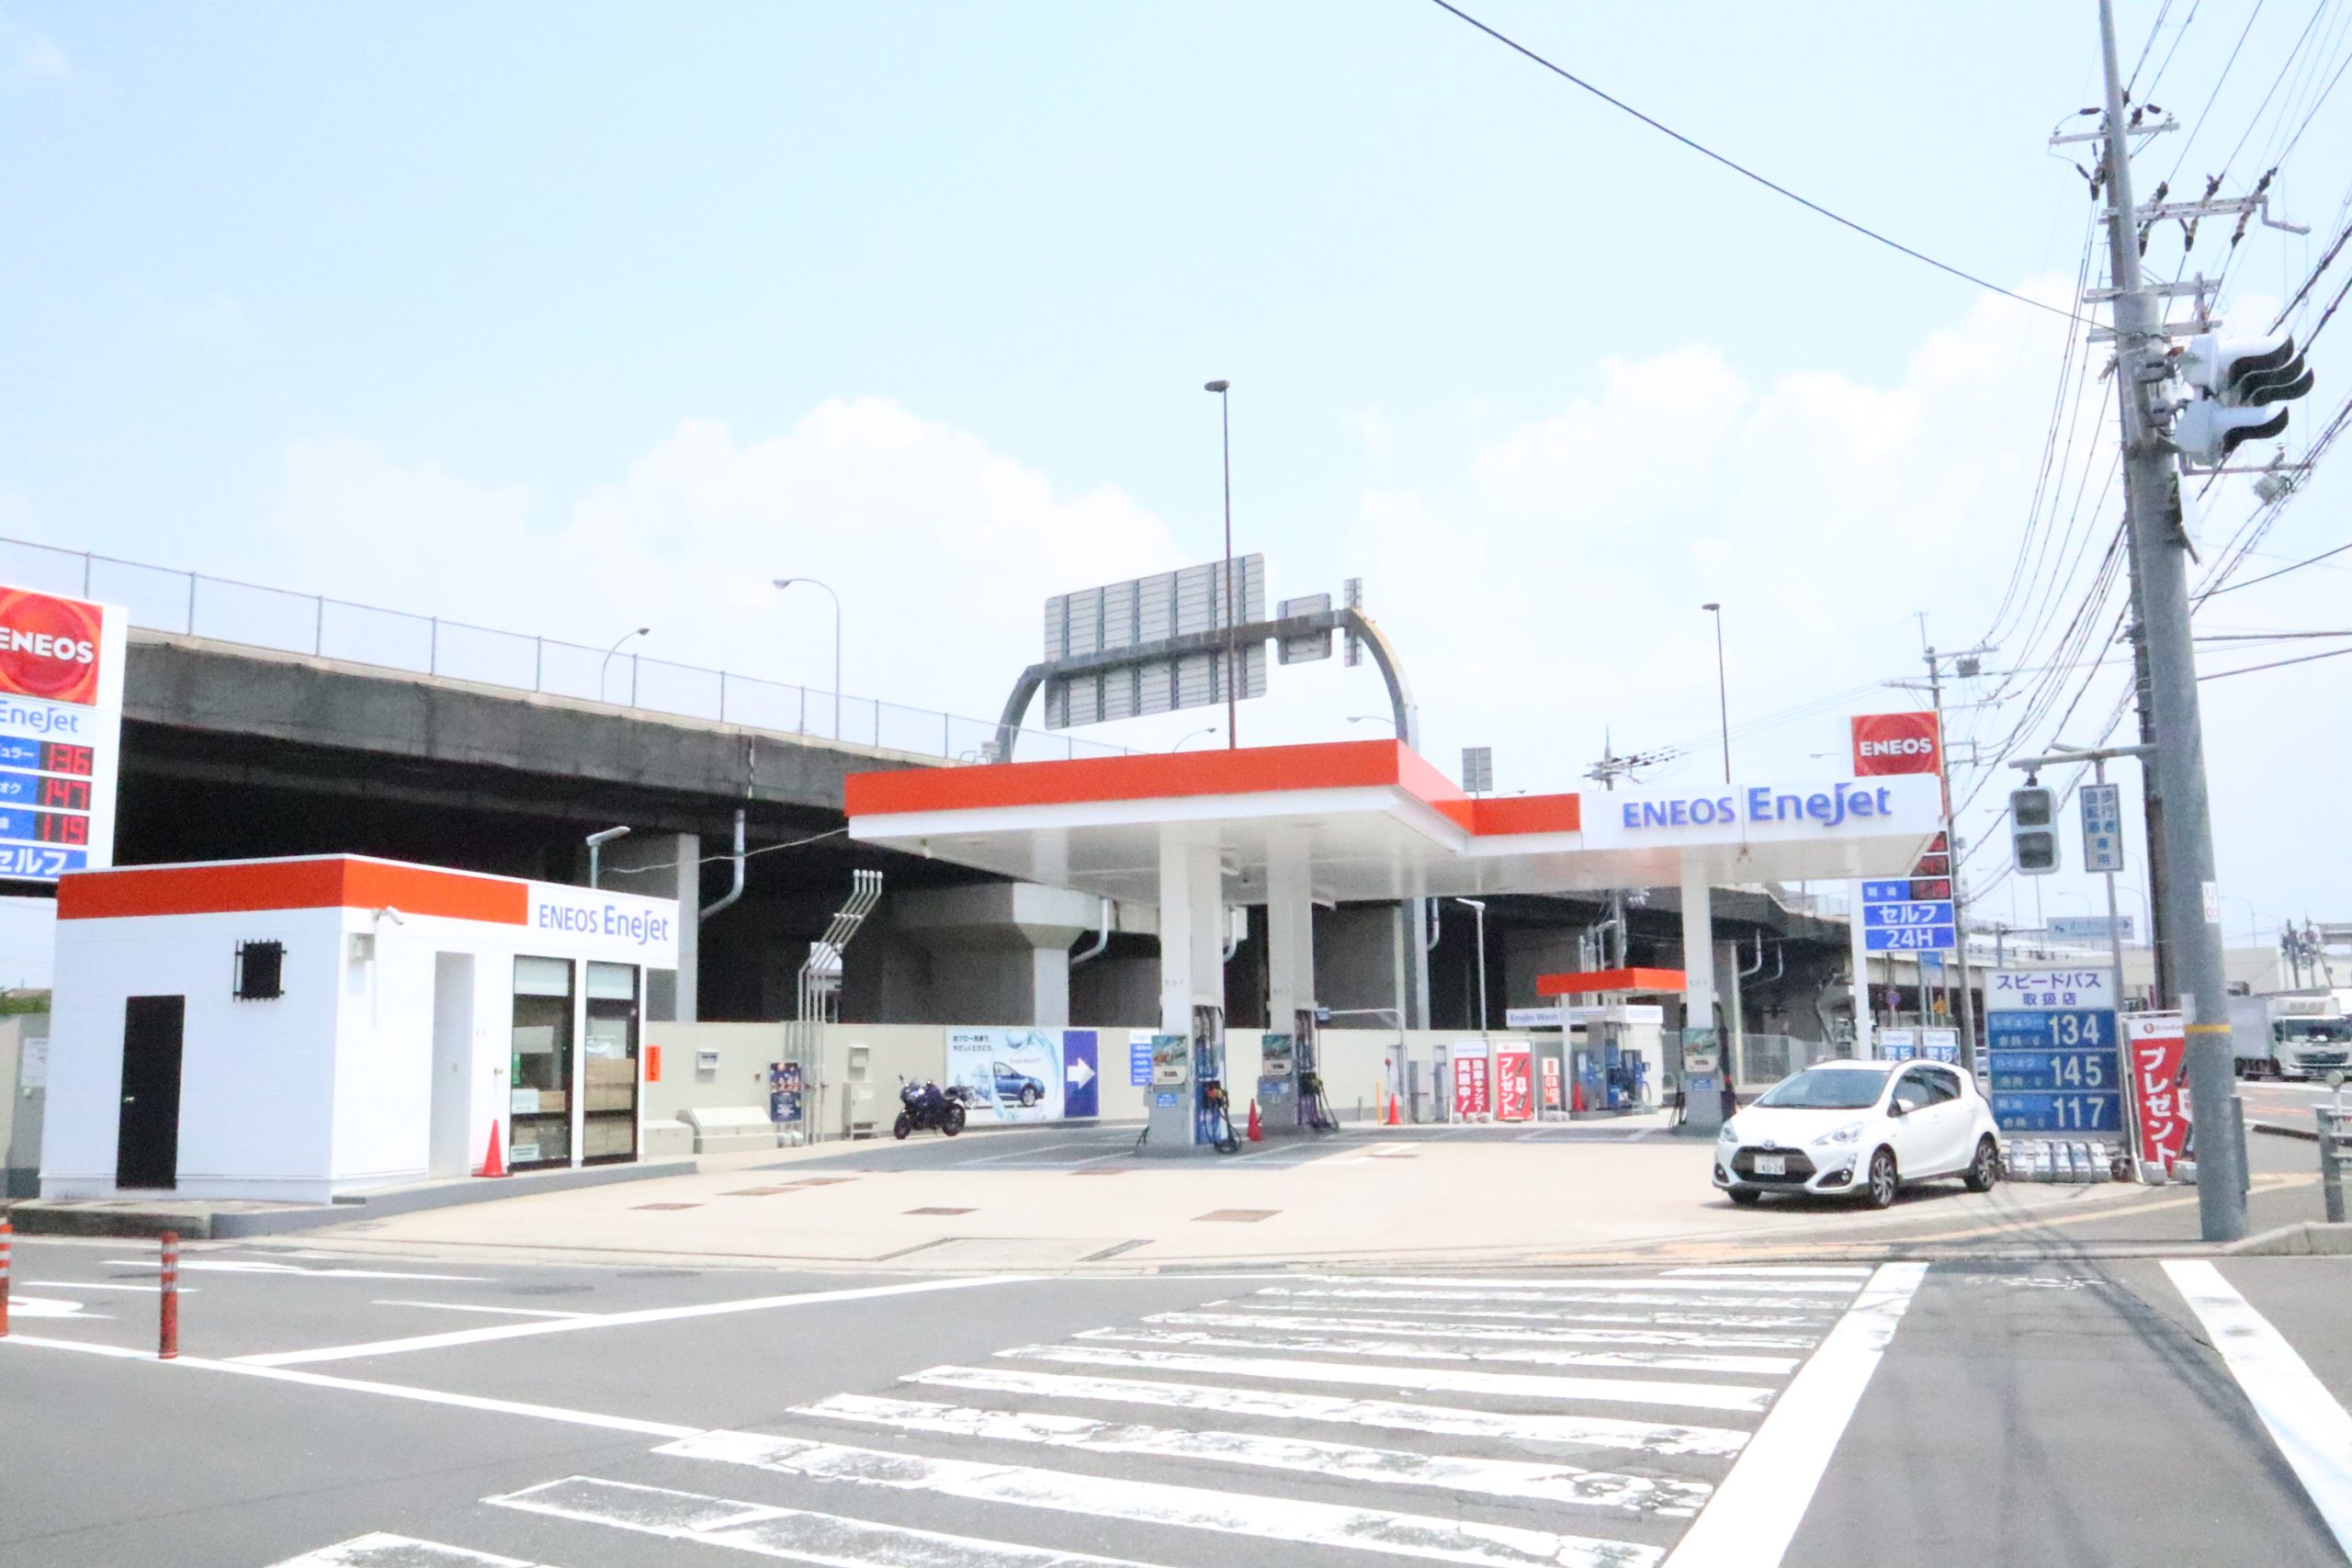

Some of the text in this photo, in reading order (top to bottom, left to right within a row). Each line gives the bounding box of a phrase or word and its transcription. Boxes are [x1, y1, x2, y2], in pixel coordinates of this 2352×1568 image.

[0, 626, 95, 664] ENEOS
[0, 699, 79, 733] Enejet
[1860, 738, 1932, 757] ENEOS
[44, 778, 89, 810] 147
[1623, 782, 1893, 829] ENEOS Enejet
[42, 813, 87, 845] 119
[538, 904, 669, 945] ENEOS Enejet
[1879, 905, 1937, 924] セルフ
[1885, 929, 1934, 949] 24H
[2022, 993, 2076, 1006] 取扱店
[2048, 1014, 2100, 1045] 134
[1501, 1056, 1514, 1115] プレゼント
[2051, 1055, 2102, 1087] 145
[2053, 1097, 2104, 1128] 117
[2140, 1046, 2177, 1171] プレゼント
